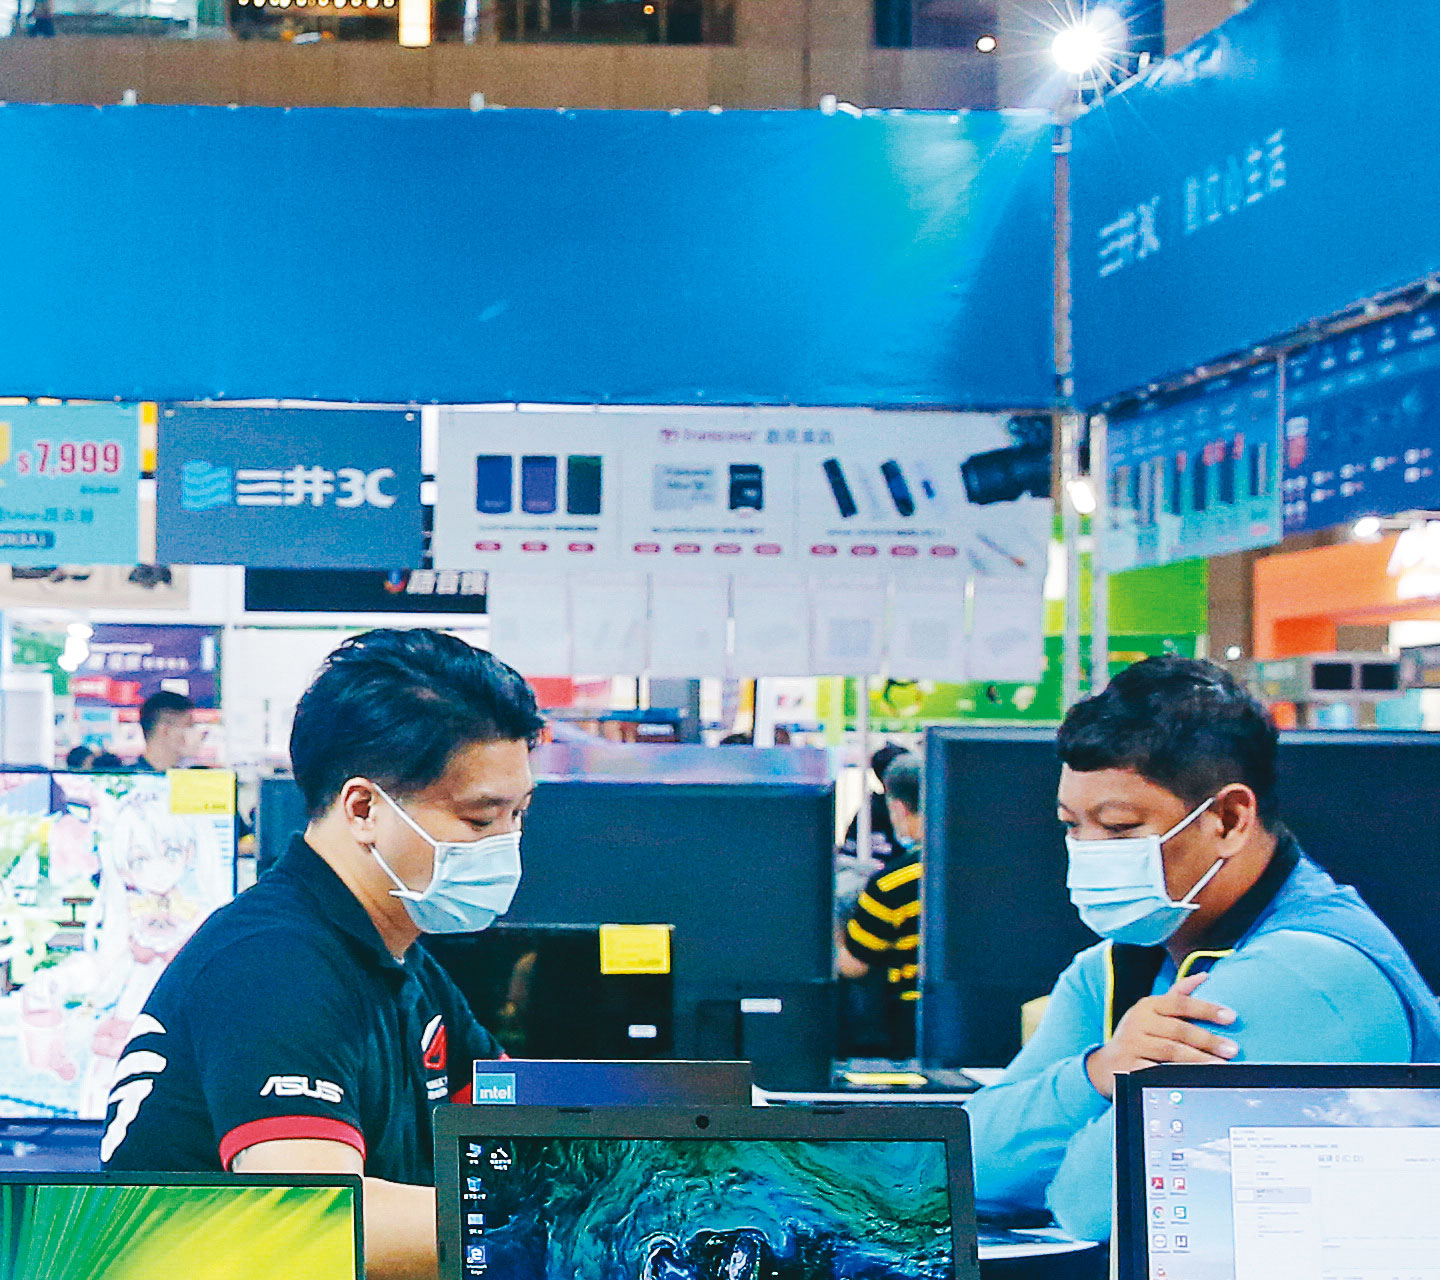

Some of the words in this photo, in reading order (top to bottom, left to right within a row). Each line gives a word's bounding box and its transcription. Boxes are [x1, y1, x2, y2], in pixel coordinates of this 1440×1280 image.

[235, 466, 398, 510] 三井3C
[260, 1076, 344, 1103] ASUS
[479, 1086, 512, 1100] intel
